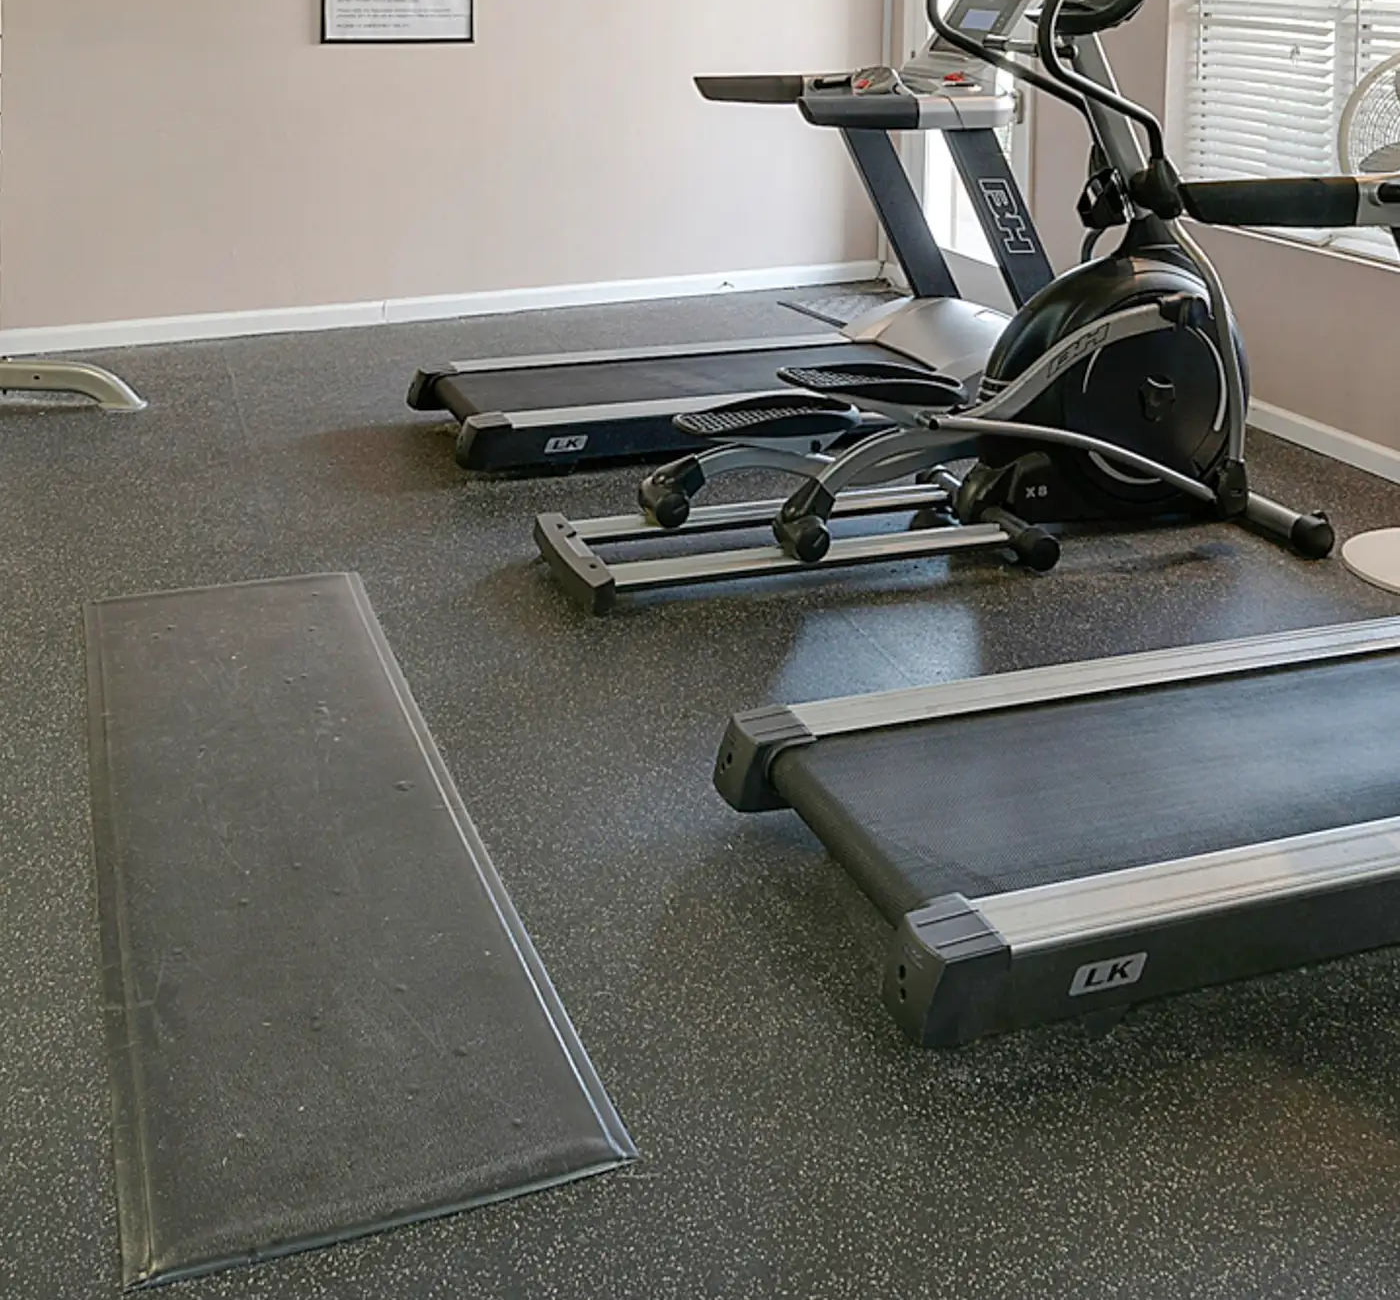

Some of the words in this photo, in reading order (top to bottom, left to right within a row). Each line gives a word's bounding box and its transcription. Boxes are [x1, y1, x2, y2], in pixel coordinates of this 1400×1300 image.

[979, 177, 1036, 253] BH
[1025, 484, 1049, 499] X8
[1084, 959, 1135, 989] LK
